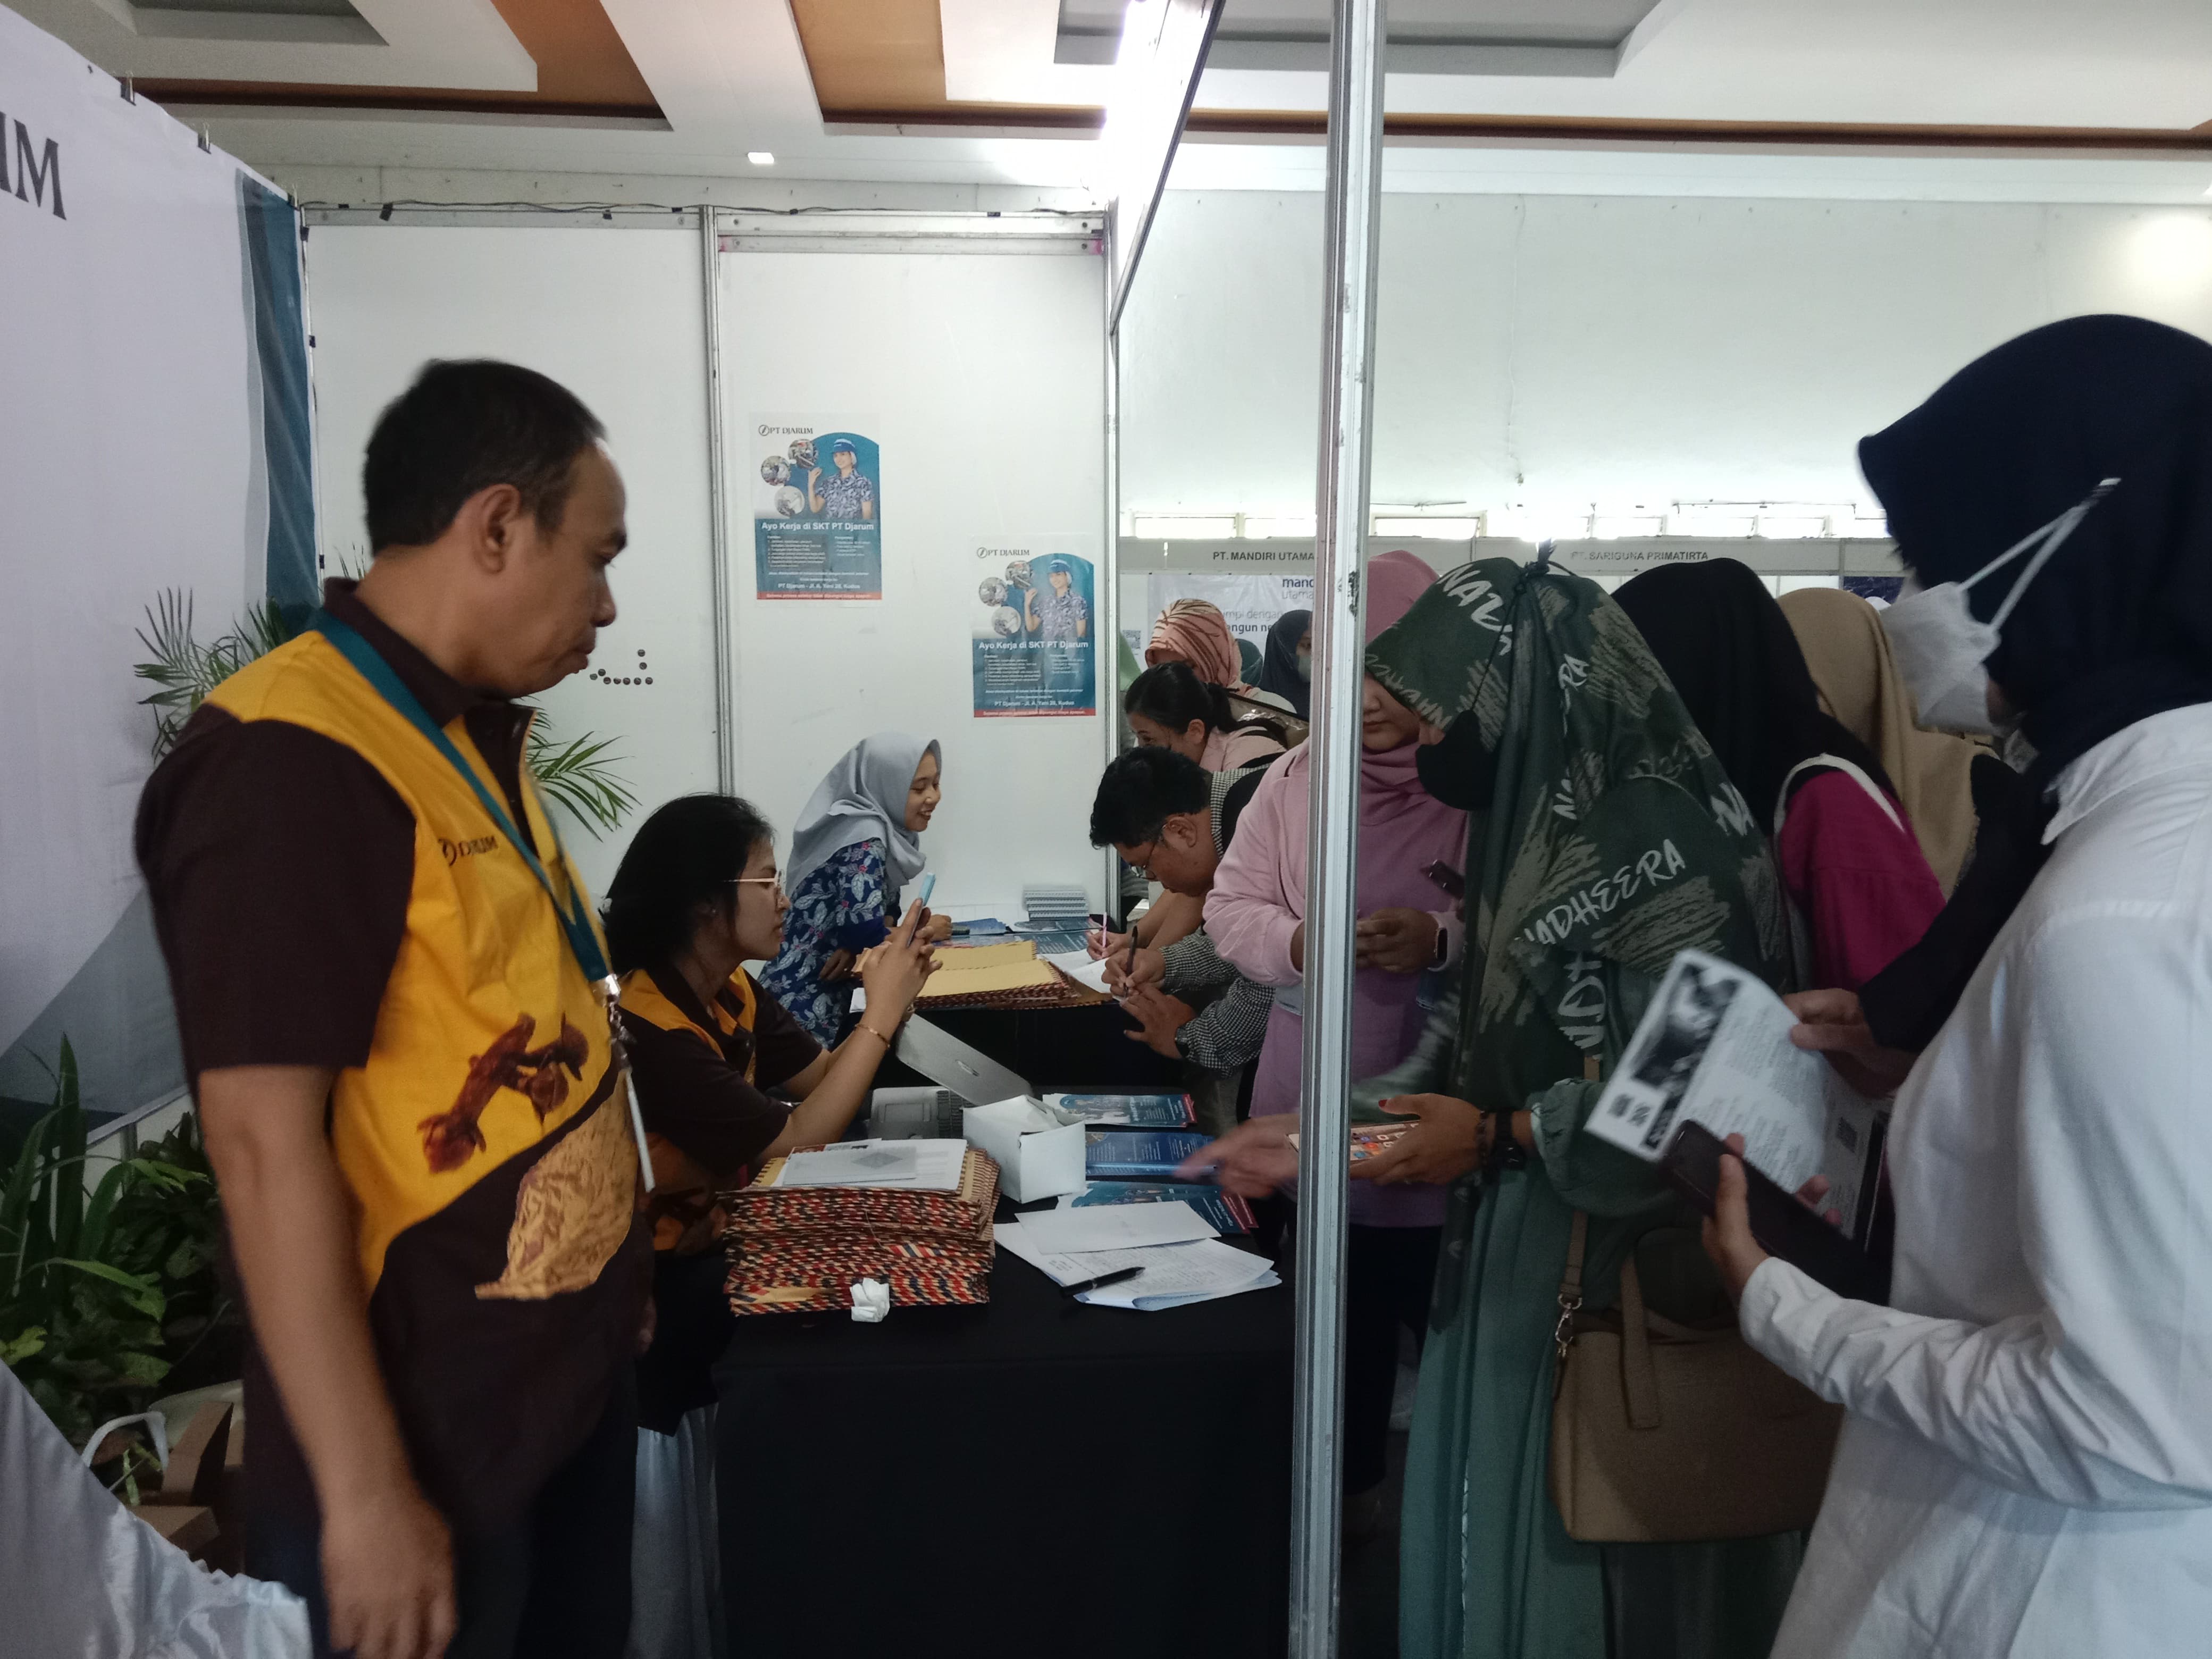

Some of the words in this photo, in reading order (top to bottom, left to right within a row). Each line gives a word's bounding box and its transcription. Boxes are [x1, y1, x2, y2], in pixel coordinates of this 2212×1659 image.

[761, 522, 777, 531] Ayo
[780, 522, 801, 531] Kerja
[1589, 551, 1645, 560] SARIGUNA
[1647, 551, 1708, 560] PRIMATIRTA
[979, 641, 995, 650] Ayo
[996, 641, 1017, 650] Kerja
[1060, 641, 1088, 649] Djarum
[1523, 839, 1686, 945] ADHEERA
